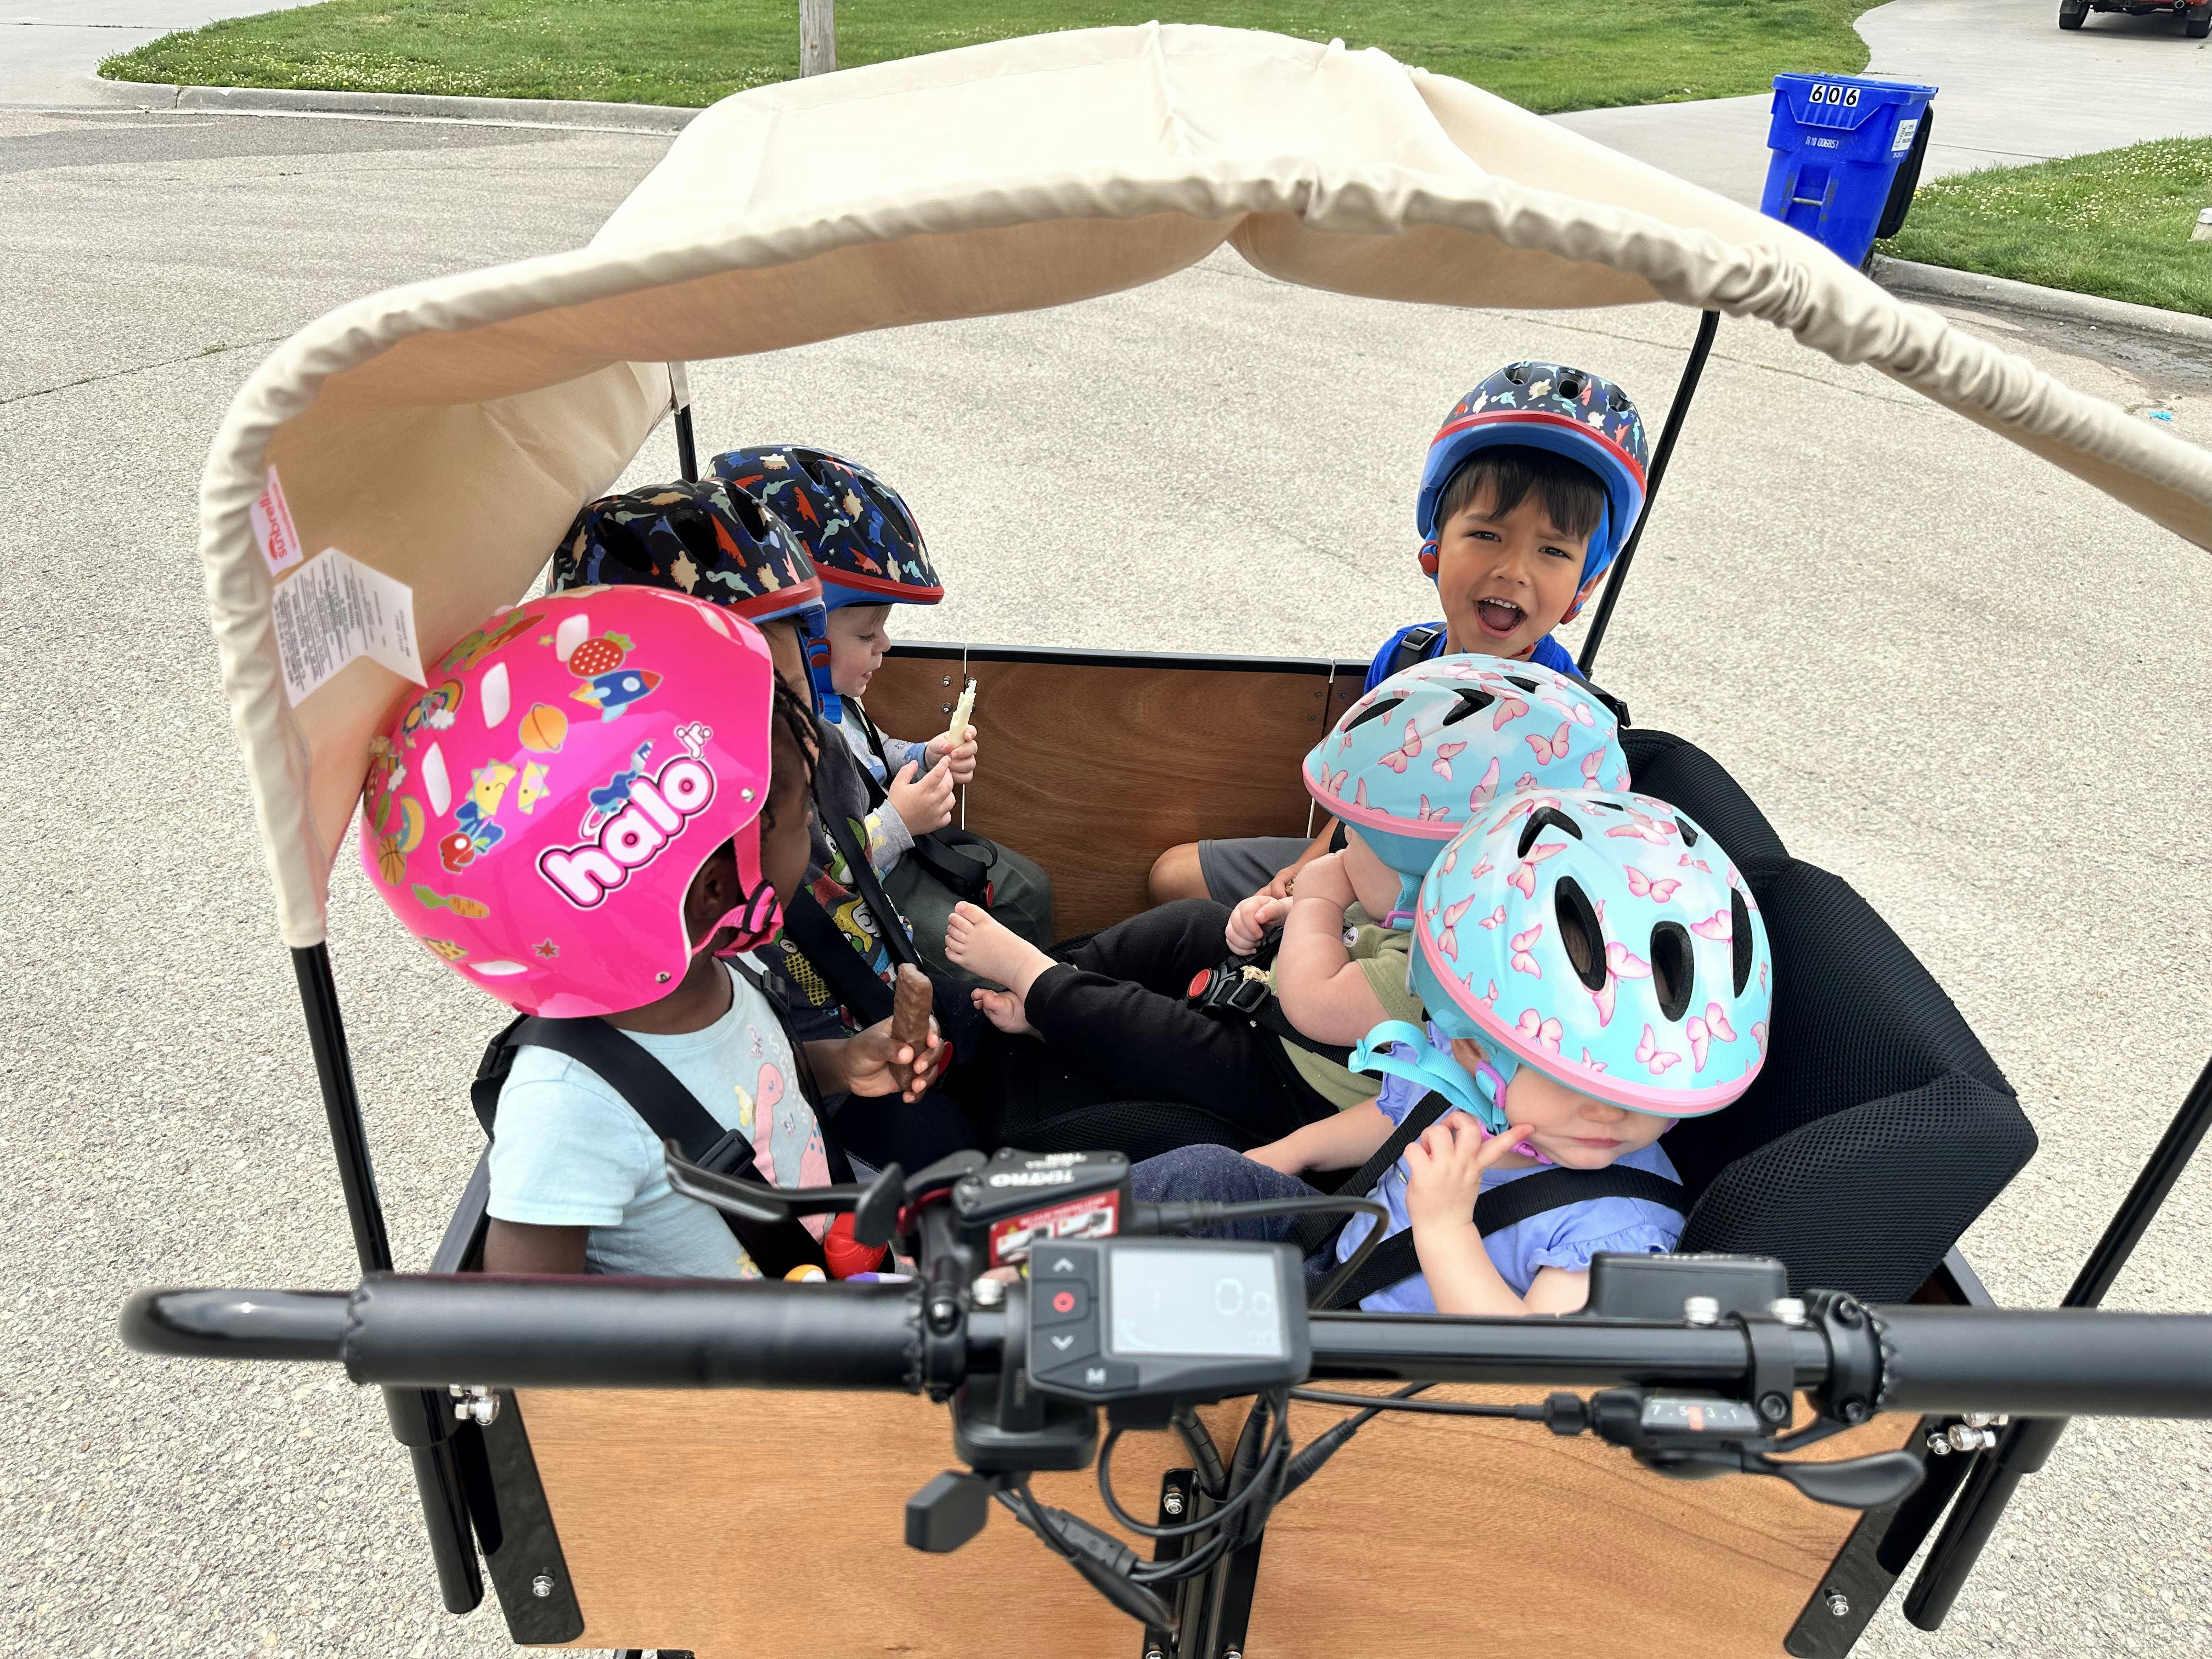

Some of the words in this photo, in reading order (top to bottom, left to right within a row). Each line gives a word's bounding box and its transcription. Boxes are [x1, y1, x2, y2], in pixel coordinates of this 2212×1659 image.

[1812, 86, 1858, 105] 606
[538, 755, 717, 910] halo
[1085, 1367, 1107, 1385] M
